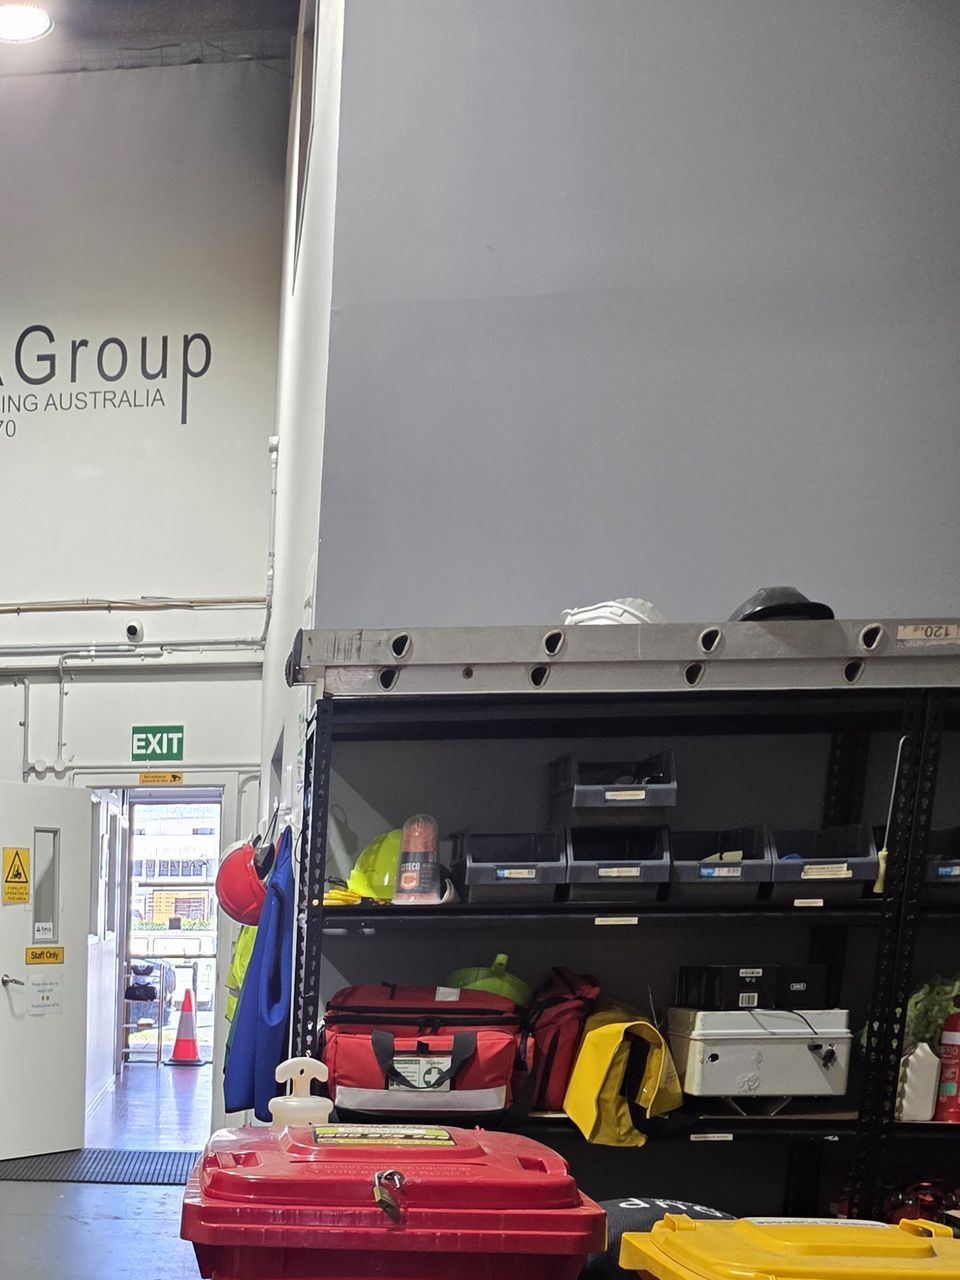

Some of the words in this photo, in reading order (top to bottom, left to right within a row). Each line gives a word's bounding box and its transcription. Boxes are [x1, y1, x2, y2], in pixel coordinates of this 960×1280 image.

[43, 388, 166, 412] AUSTRALIA
[132, 733, 183, 754] EXIT
[30, 951, 45, 960] Staff
[45, 951, 59, 961] Only
